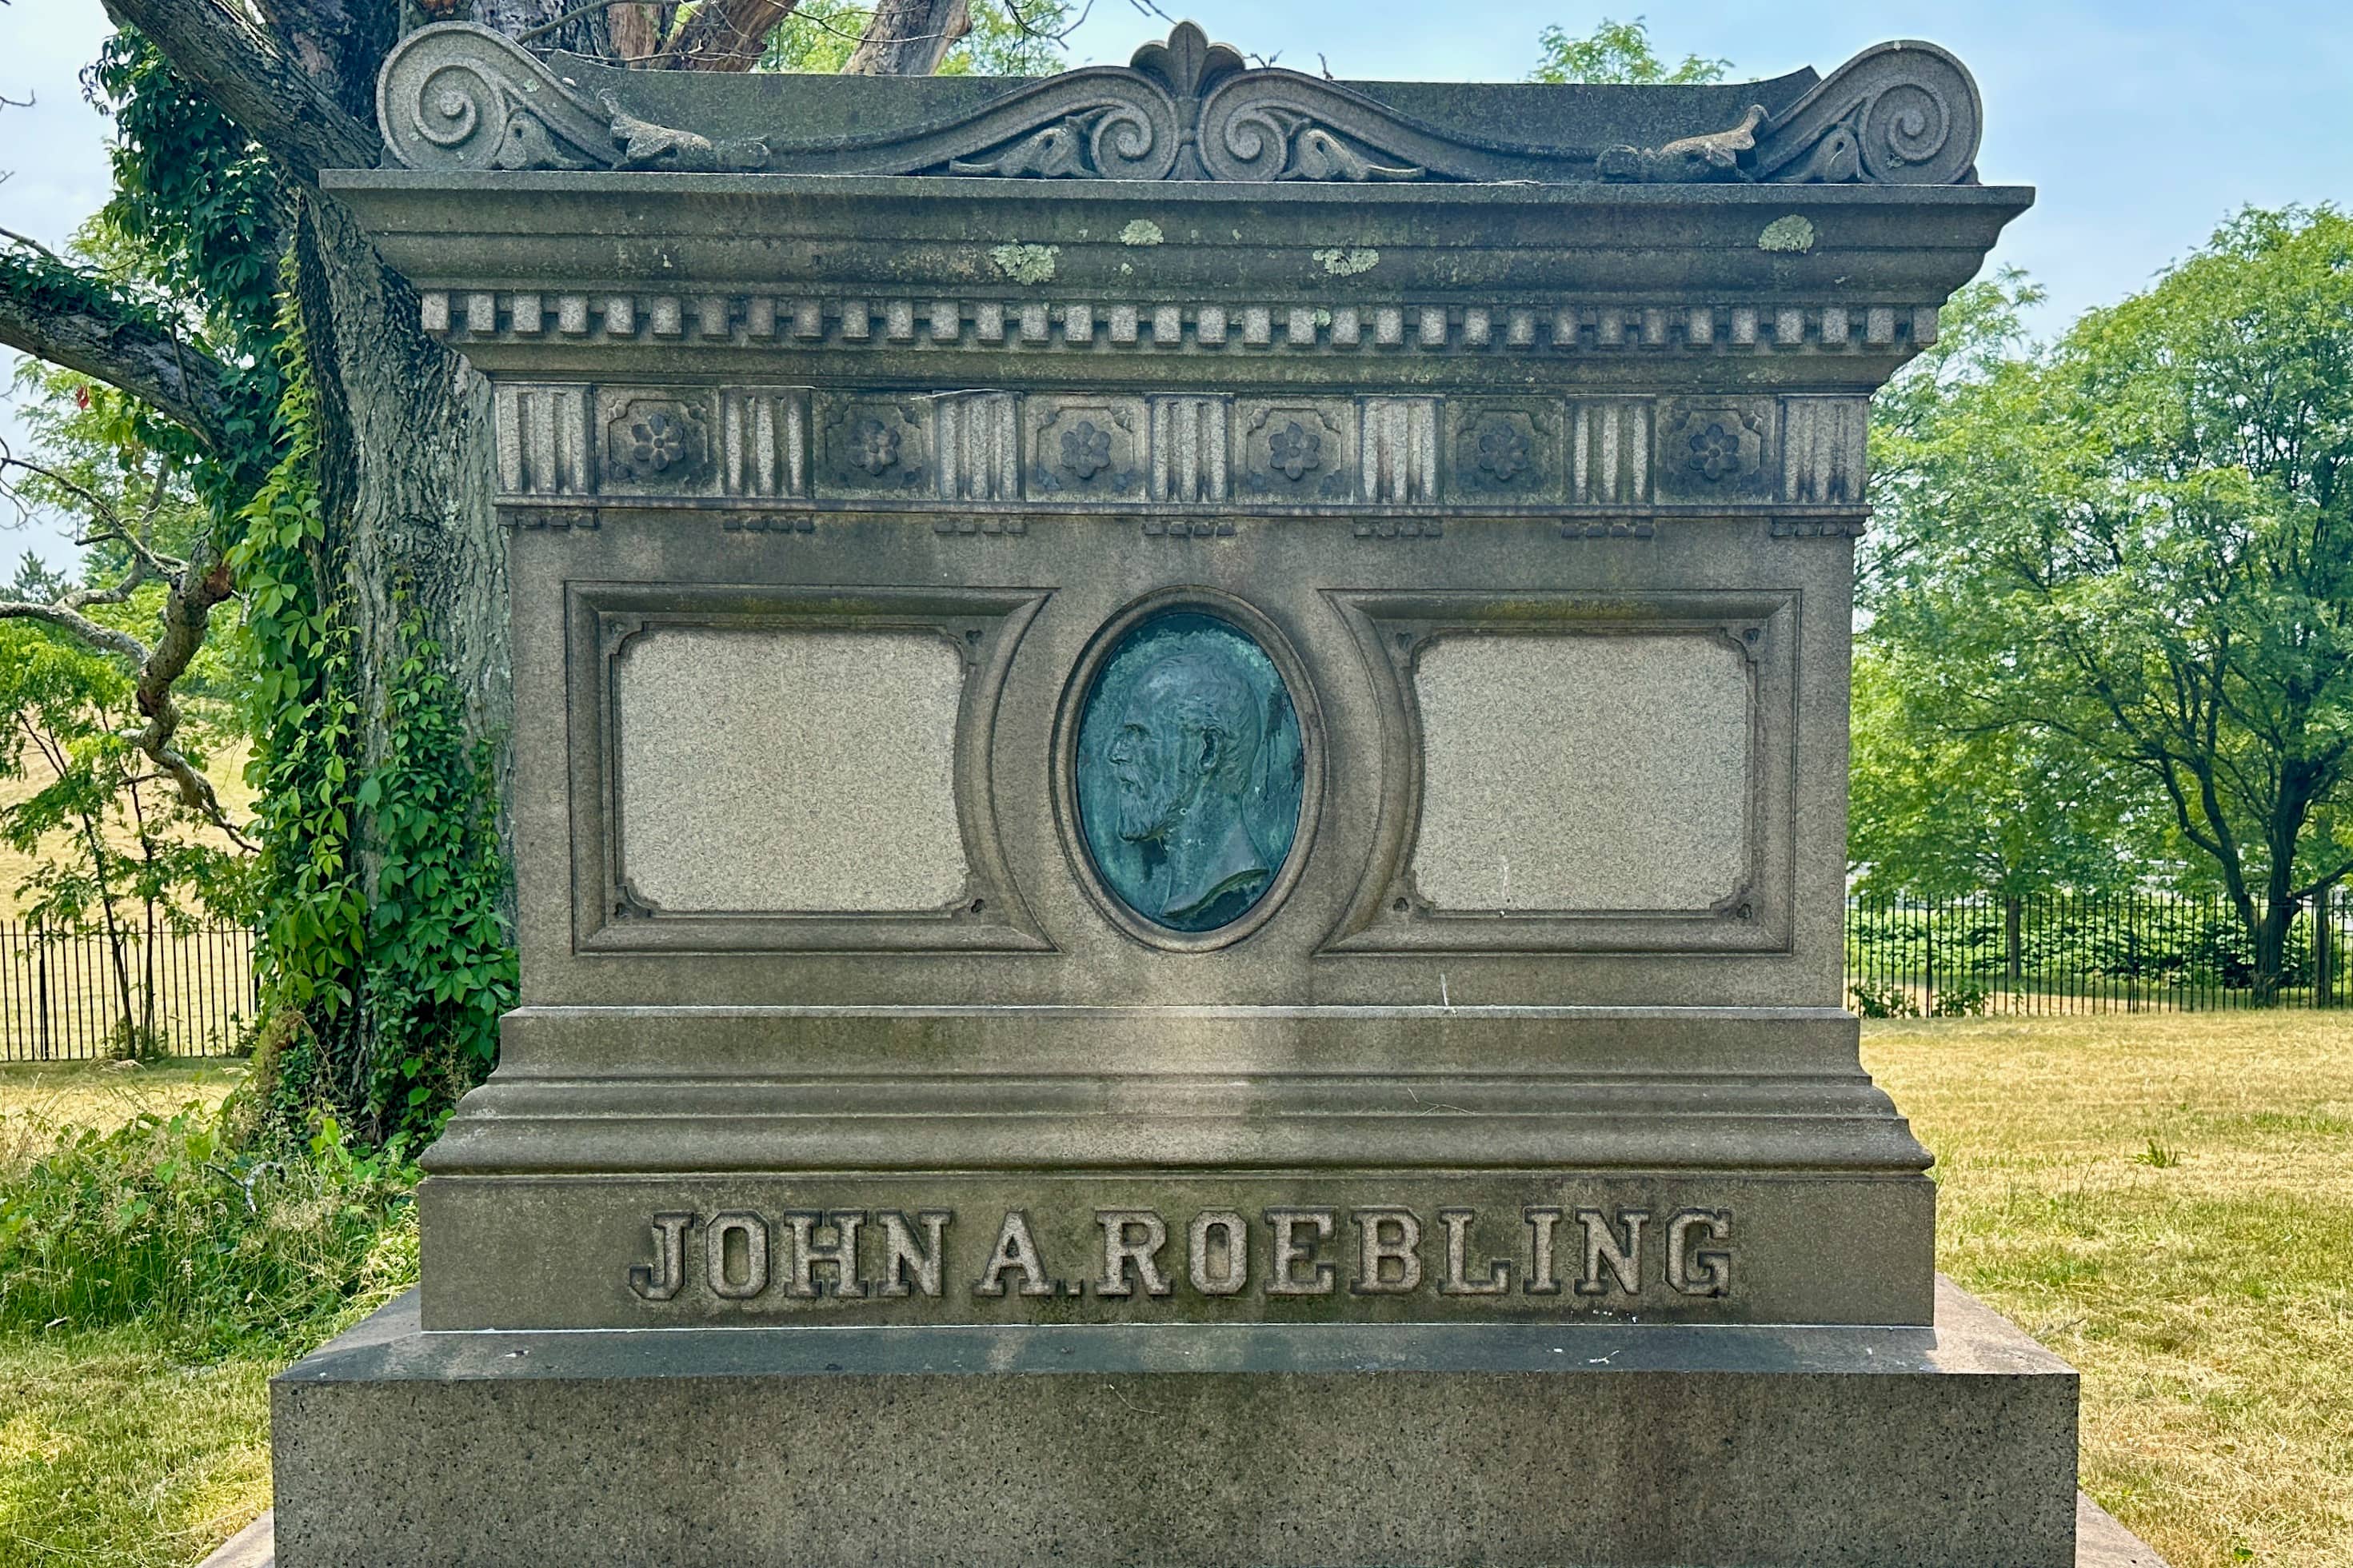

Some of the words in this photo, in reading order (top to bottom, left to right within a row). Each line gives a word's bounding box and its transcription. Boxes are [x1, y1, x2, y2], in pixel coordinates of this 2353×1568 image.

[629, 1209, 953, 1300] JOHN
[973, 1207, 1082, 1297] A.
[1094, 1206, 1732, 1298] ROEBLING
